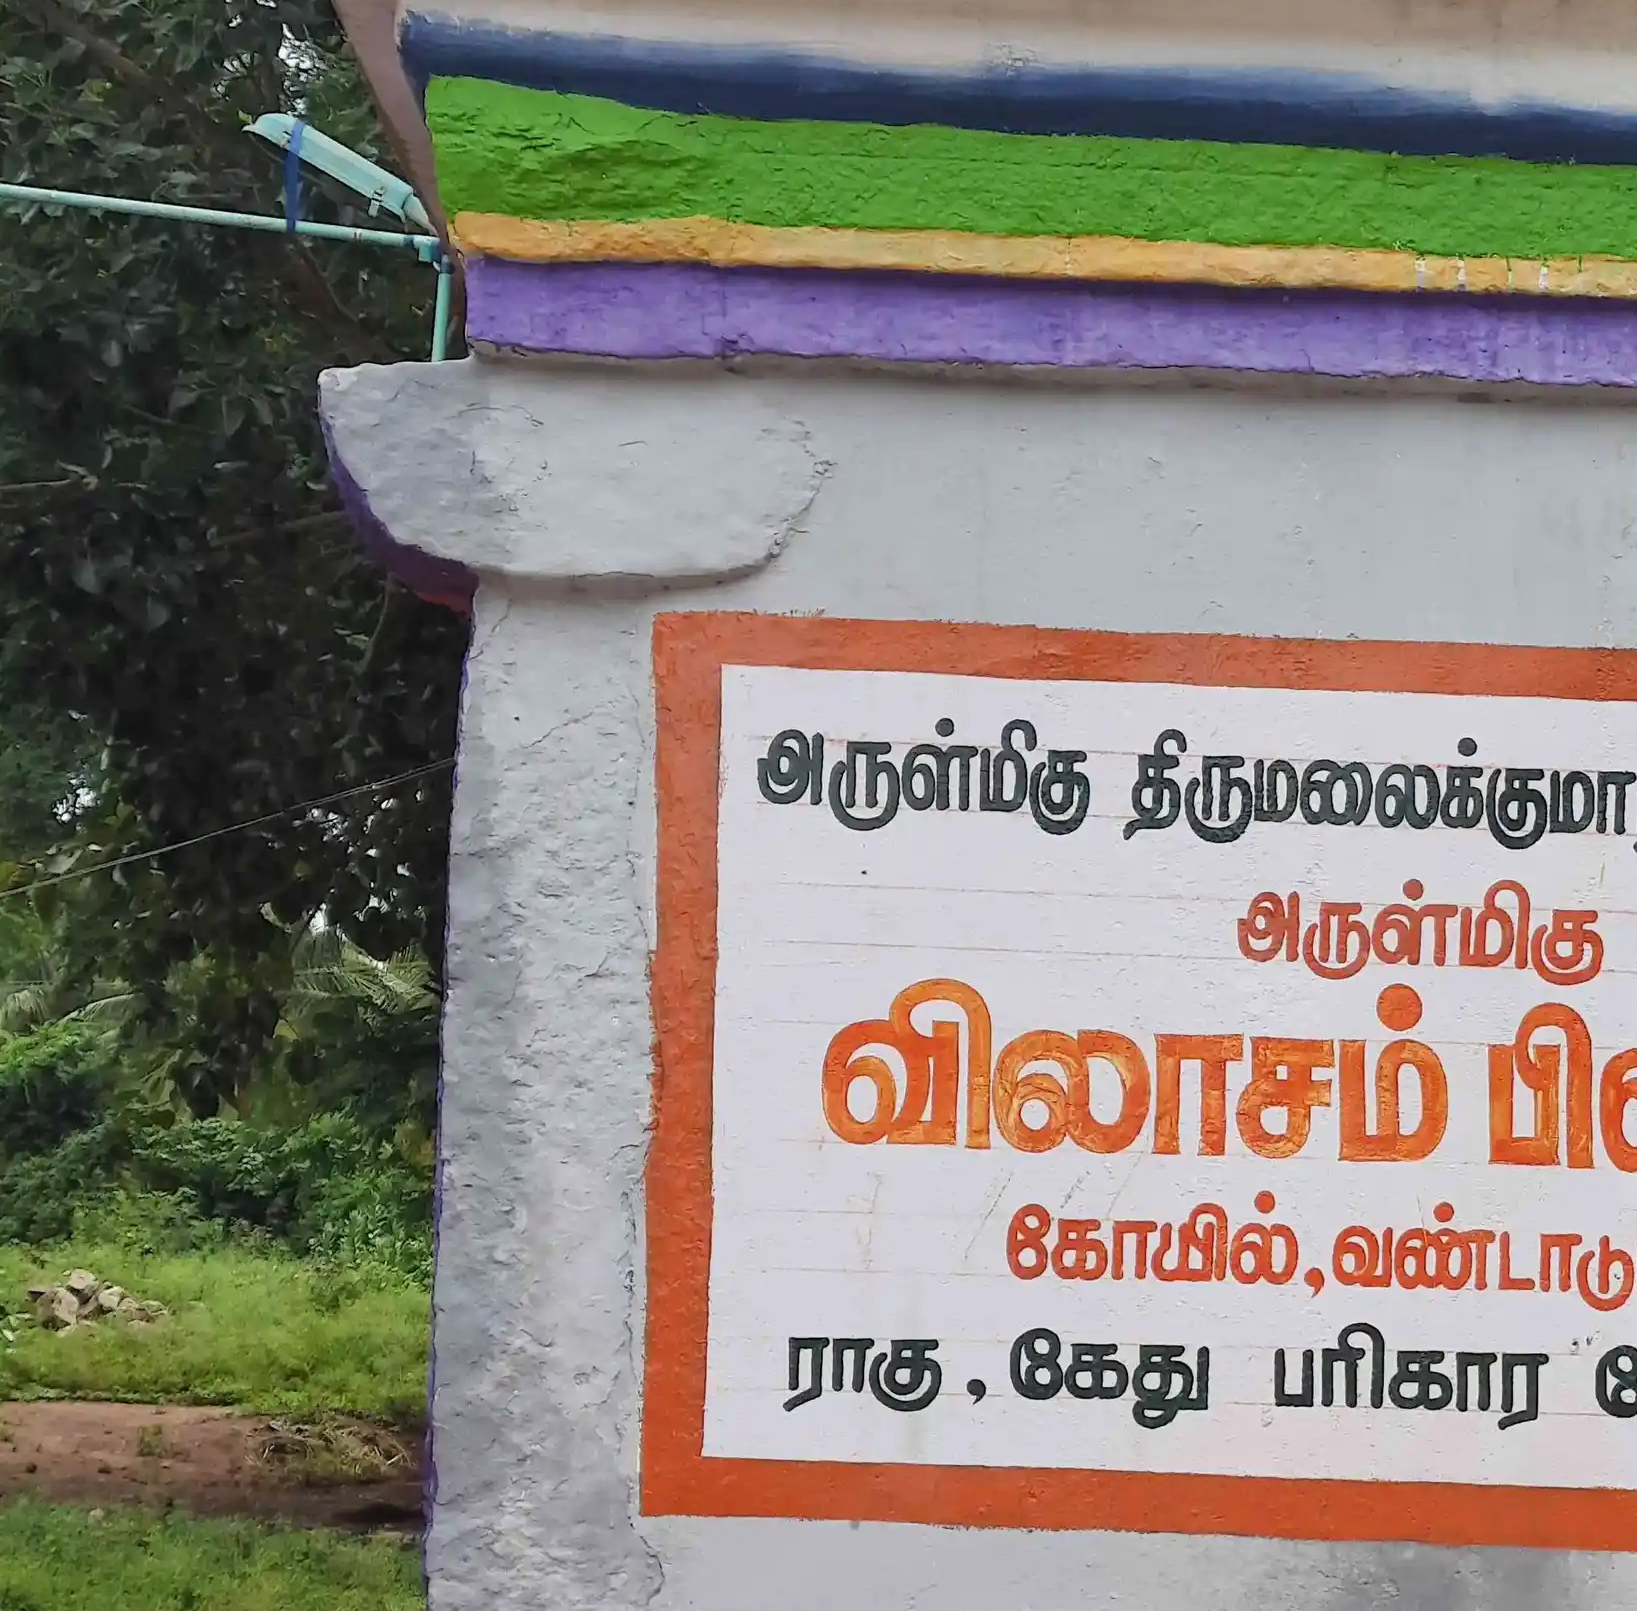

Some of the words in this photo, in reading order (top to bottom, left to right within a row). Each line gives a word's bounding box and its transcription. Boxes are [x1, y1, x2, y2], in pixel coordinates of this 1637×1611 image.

[757, 717, 1091, 836] அருள்மிகு
[1237, 878, 1605, 986] அருள்மிகு
[822, 978, 1450, 1163] விலாசம்
[1009, 1327, 1210, 1430] கேது
[1274, 1322, 1550, 1431] பரிகார
